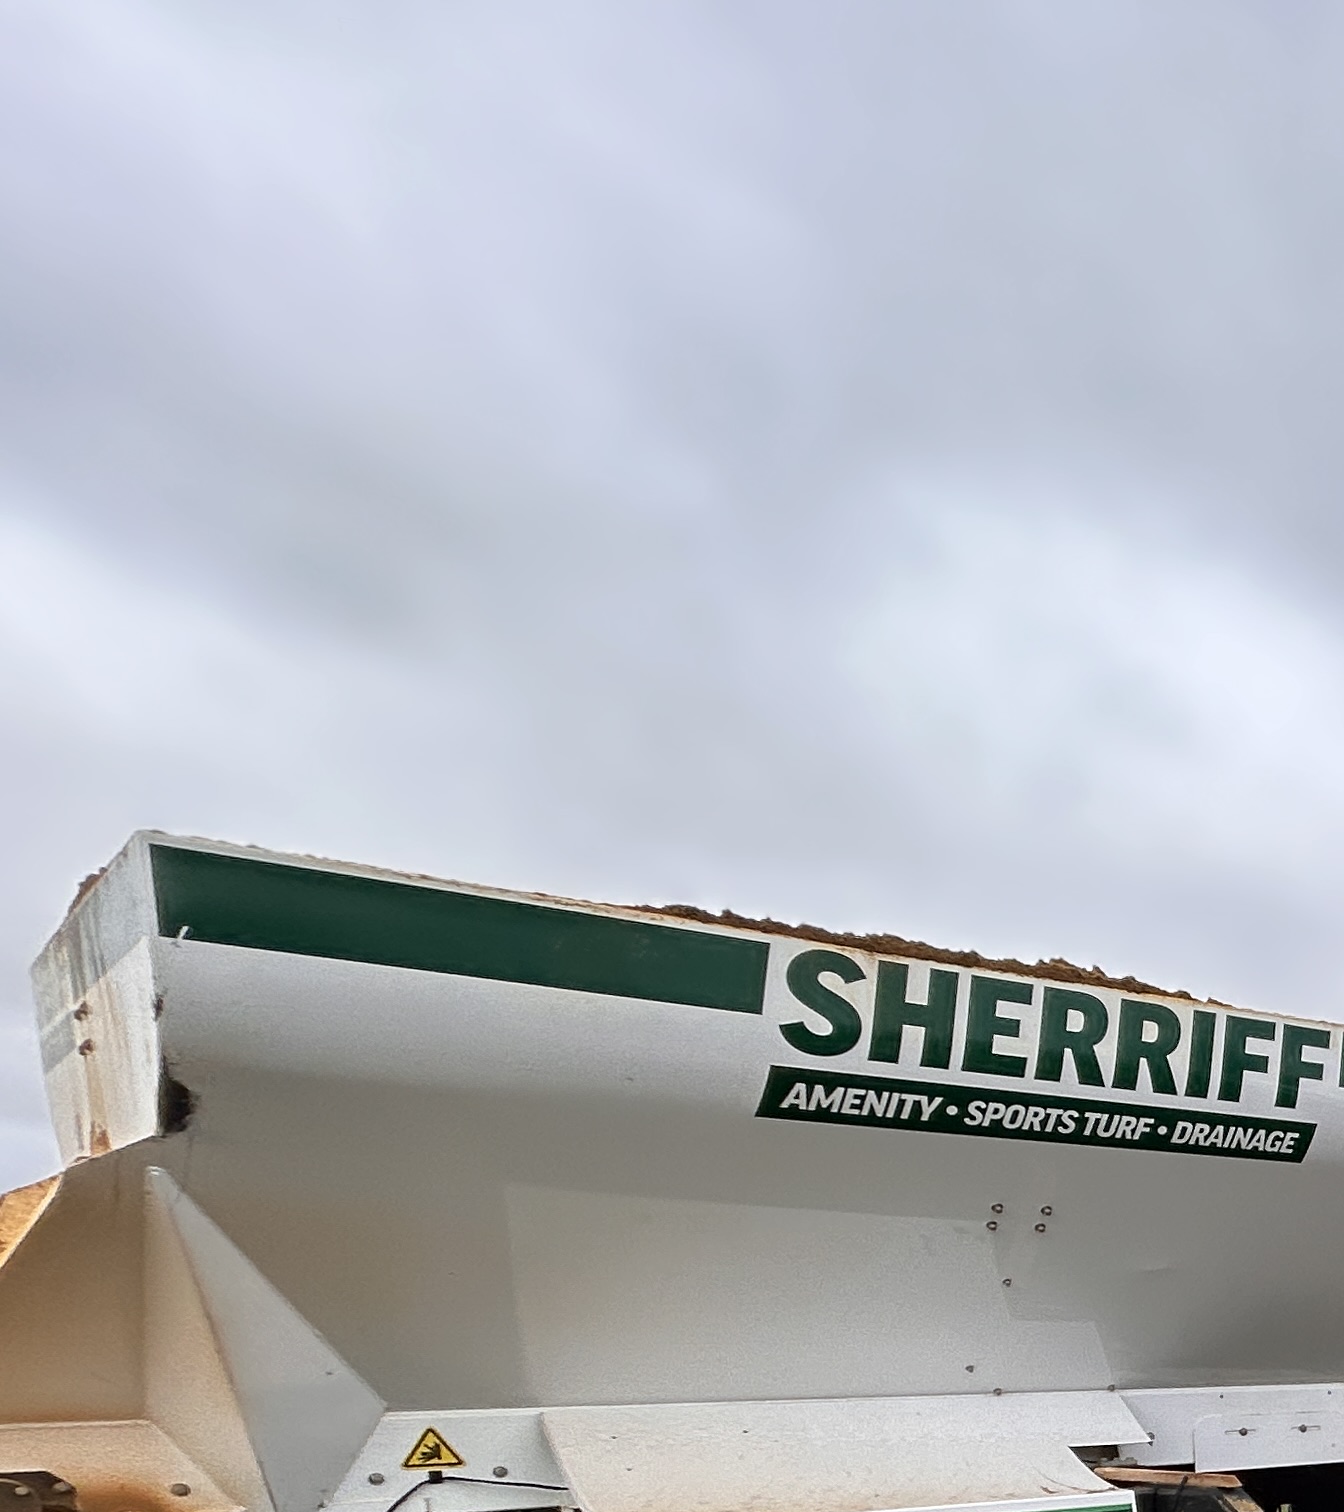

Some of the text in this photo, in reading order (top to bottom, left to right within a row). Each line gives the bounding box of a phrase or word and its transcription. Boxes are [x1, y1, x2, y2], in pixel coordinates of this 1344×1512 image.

[778, 948, 1332, 1109] SHERRIFF
[780, 1083, 1299, 1154] AMENITY SPORTS TURF DRAINAGE
